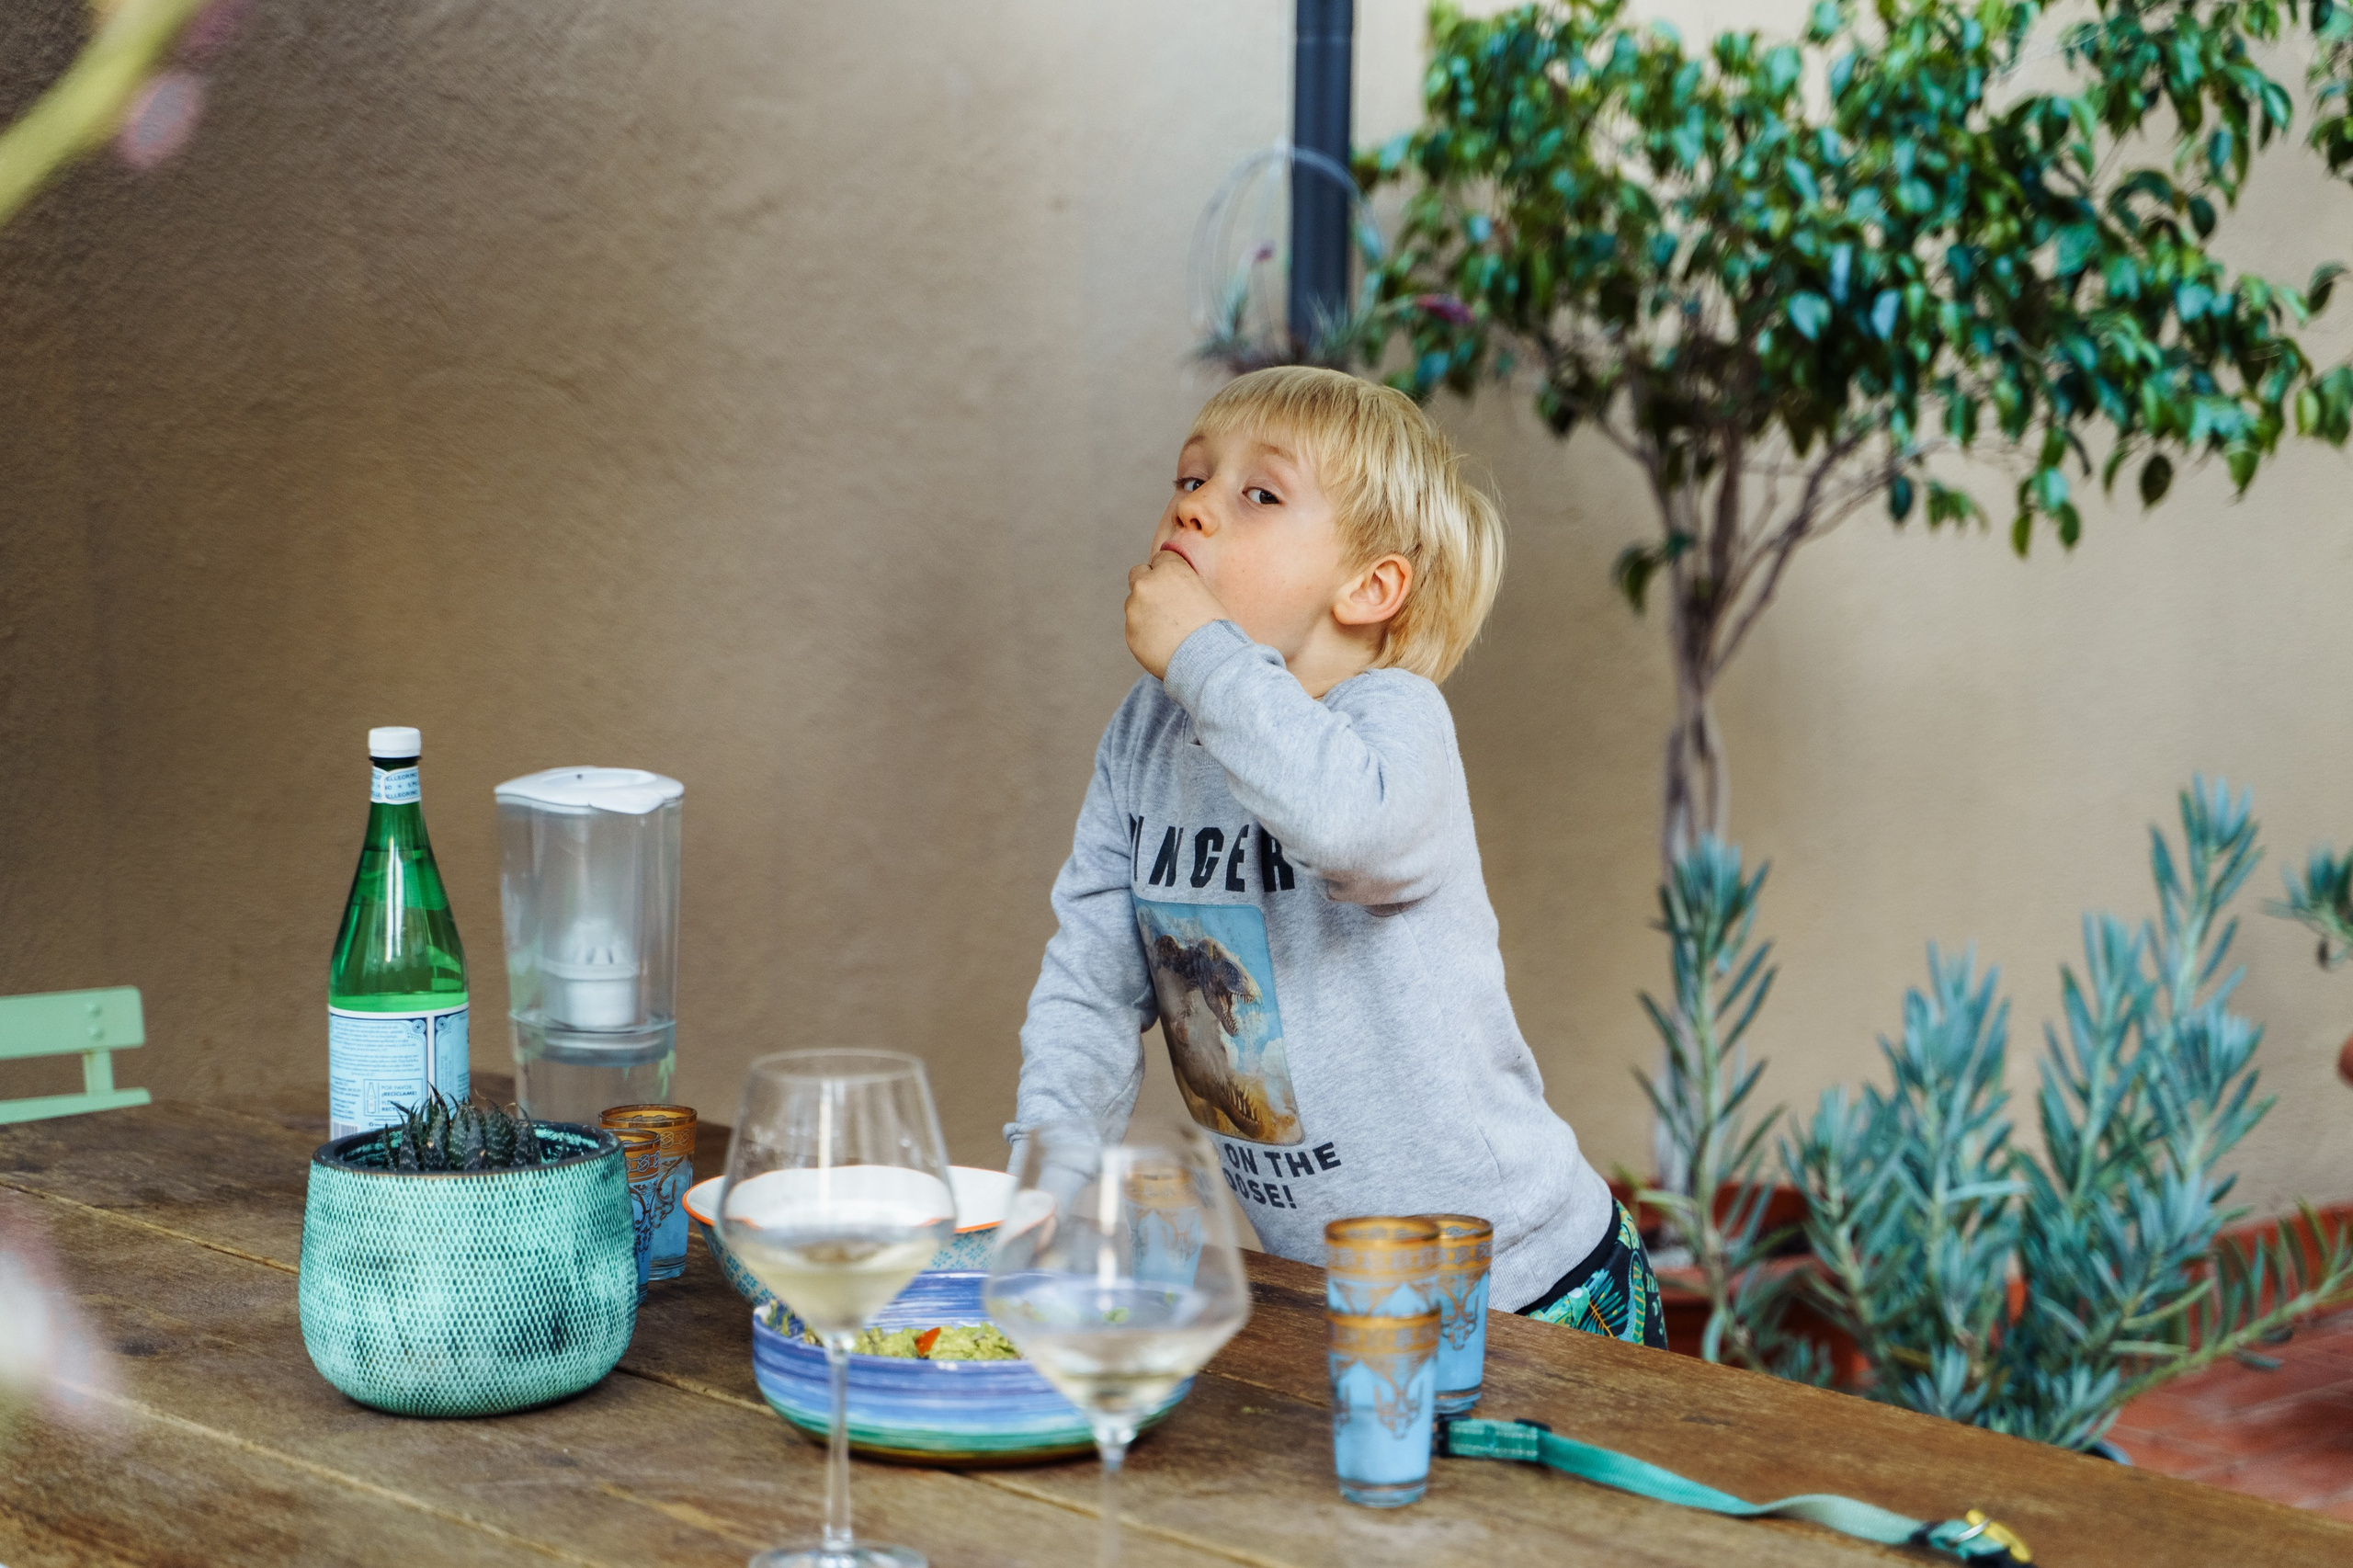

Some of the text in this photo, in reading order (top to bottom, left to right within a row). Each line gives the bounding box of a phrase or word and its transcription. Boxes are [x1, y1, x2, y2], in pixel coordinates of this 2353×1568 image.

[1129, 812, 1296, 892] NGER
[1223, 1142, 1342, 1178] ON THE
[1222, 1167, 1297, 1210] OOSE!
